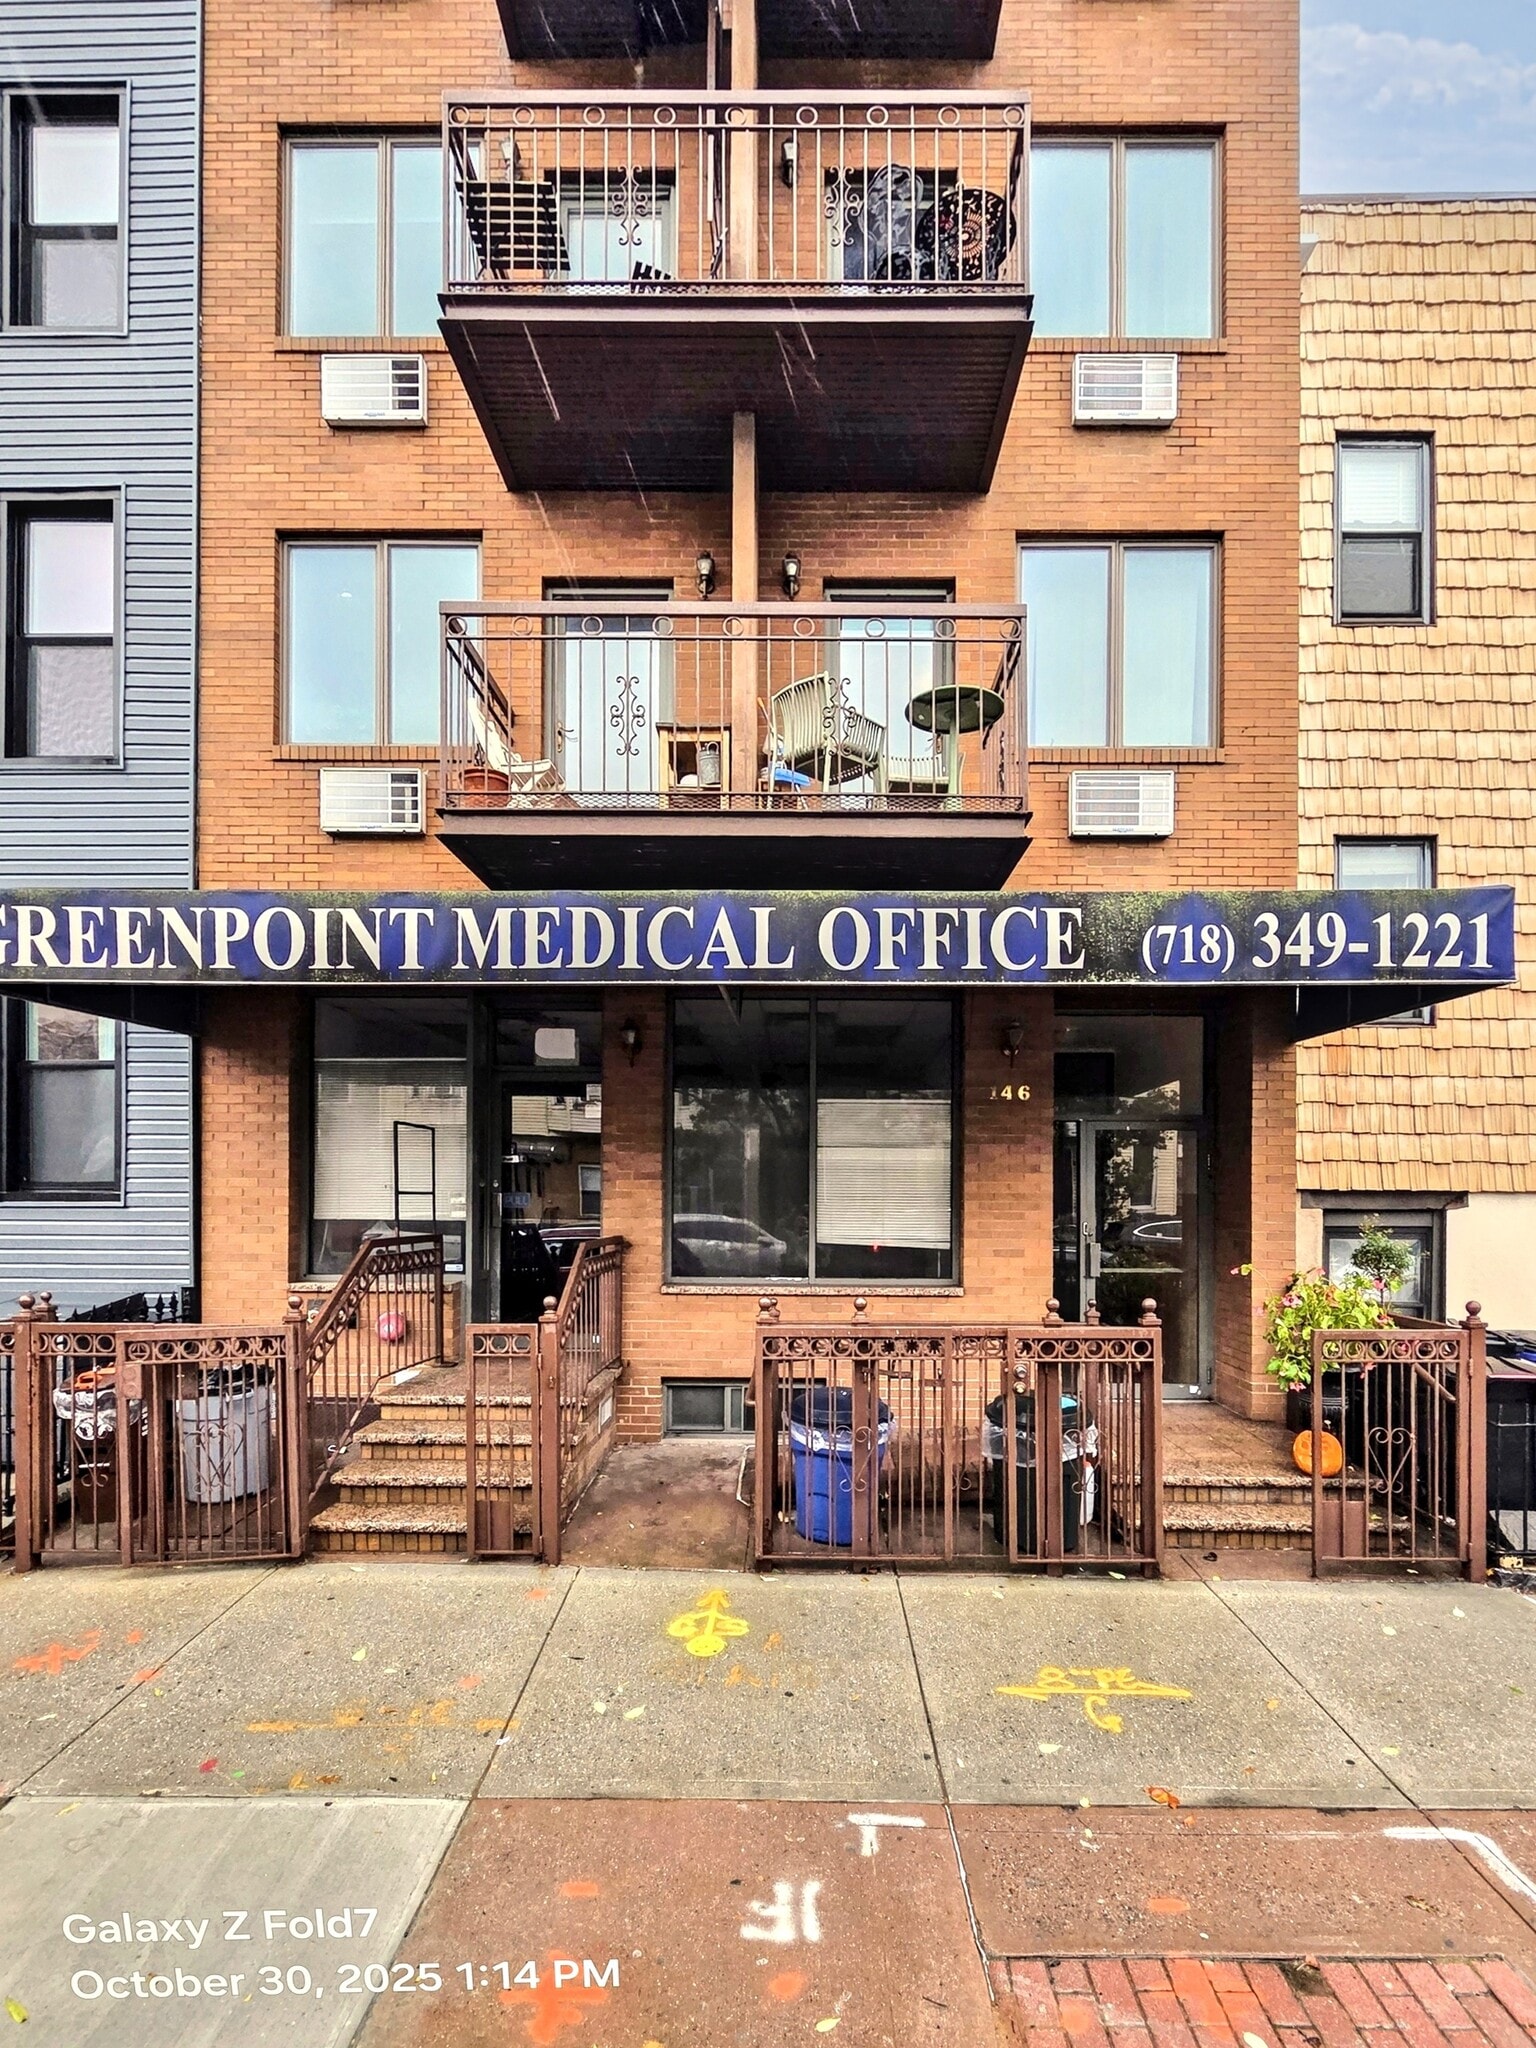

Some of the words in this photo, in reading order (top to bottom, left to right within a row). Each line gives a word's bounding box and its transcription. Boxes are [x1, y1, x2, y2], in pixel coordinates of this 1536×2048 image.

[0, 904, 434, 971] REENPOINT
[451, 905, 796, 971] MEDICAL
[817, 905, 1086, 972] OFFICE
[1142, 923, 1236, 975] (718)
[1252, 911, 1494, 970] 349-1221
